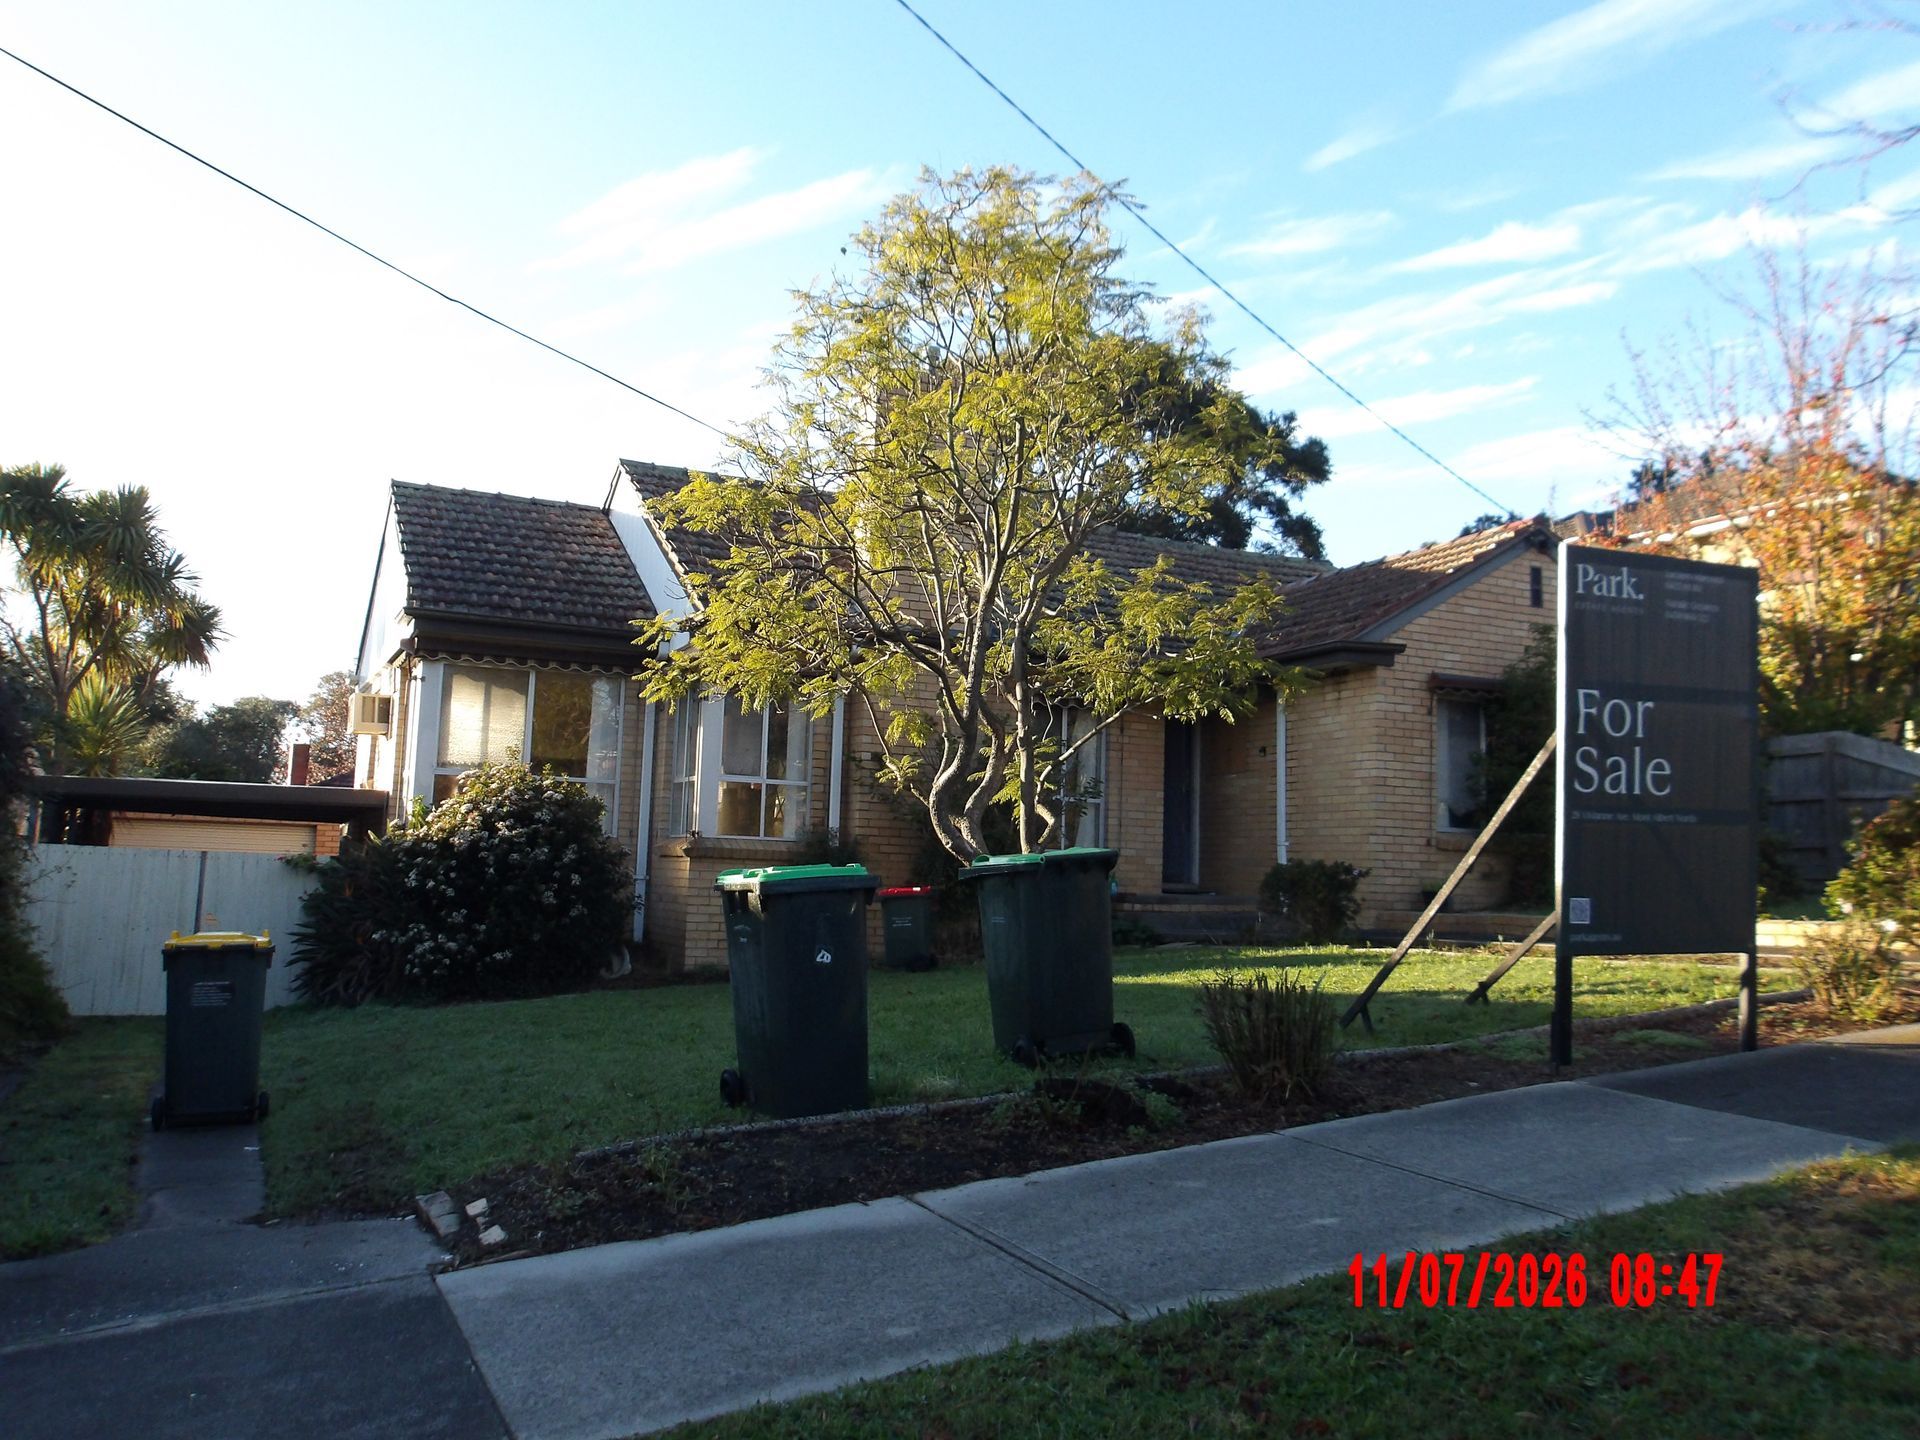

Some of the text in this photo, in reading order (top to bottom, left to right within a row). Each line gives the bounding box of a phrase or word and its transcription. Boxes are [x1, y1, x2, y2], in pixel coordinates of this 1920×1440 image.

[1575, 563, 1645, 600] Park.
[1576, 688, 1655, 738] For
[1573, 746, 1672, 796] Sale
